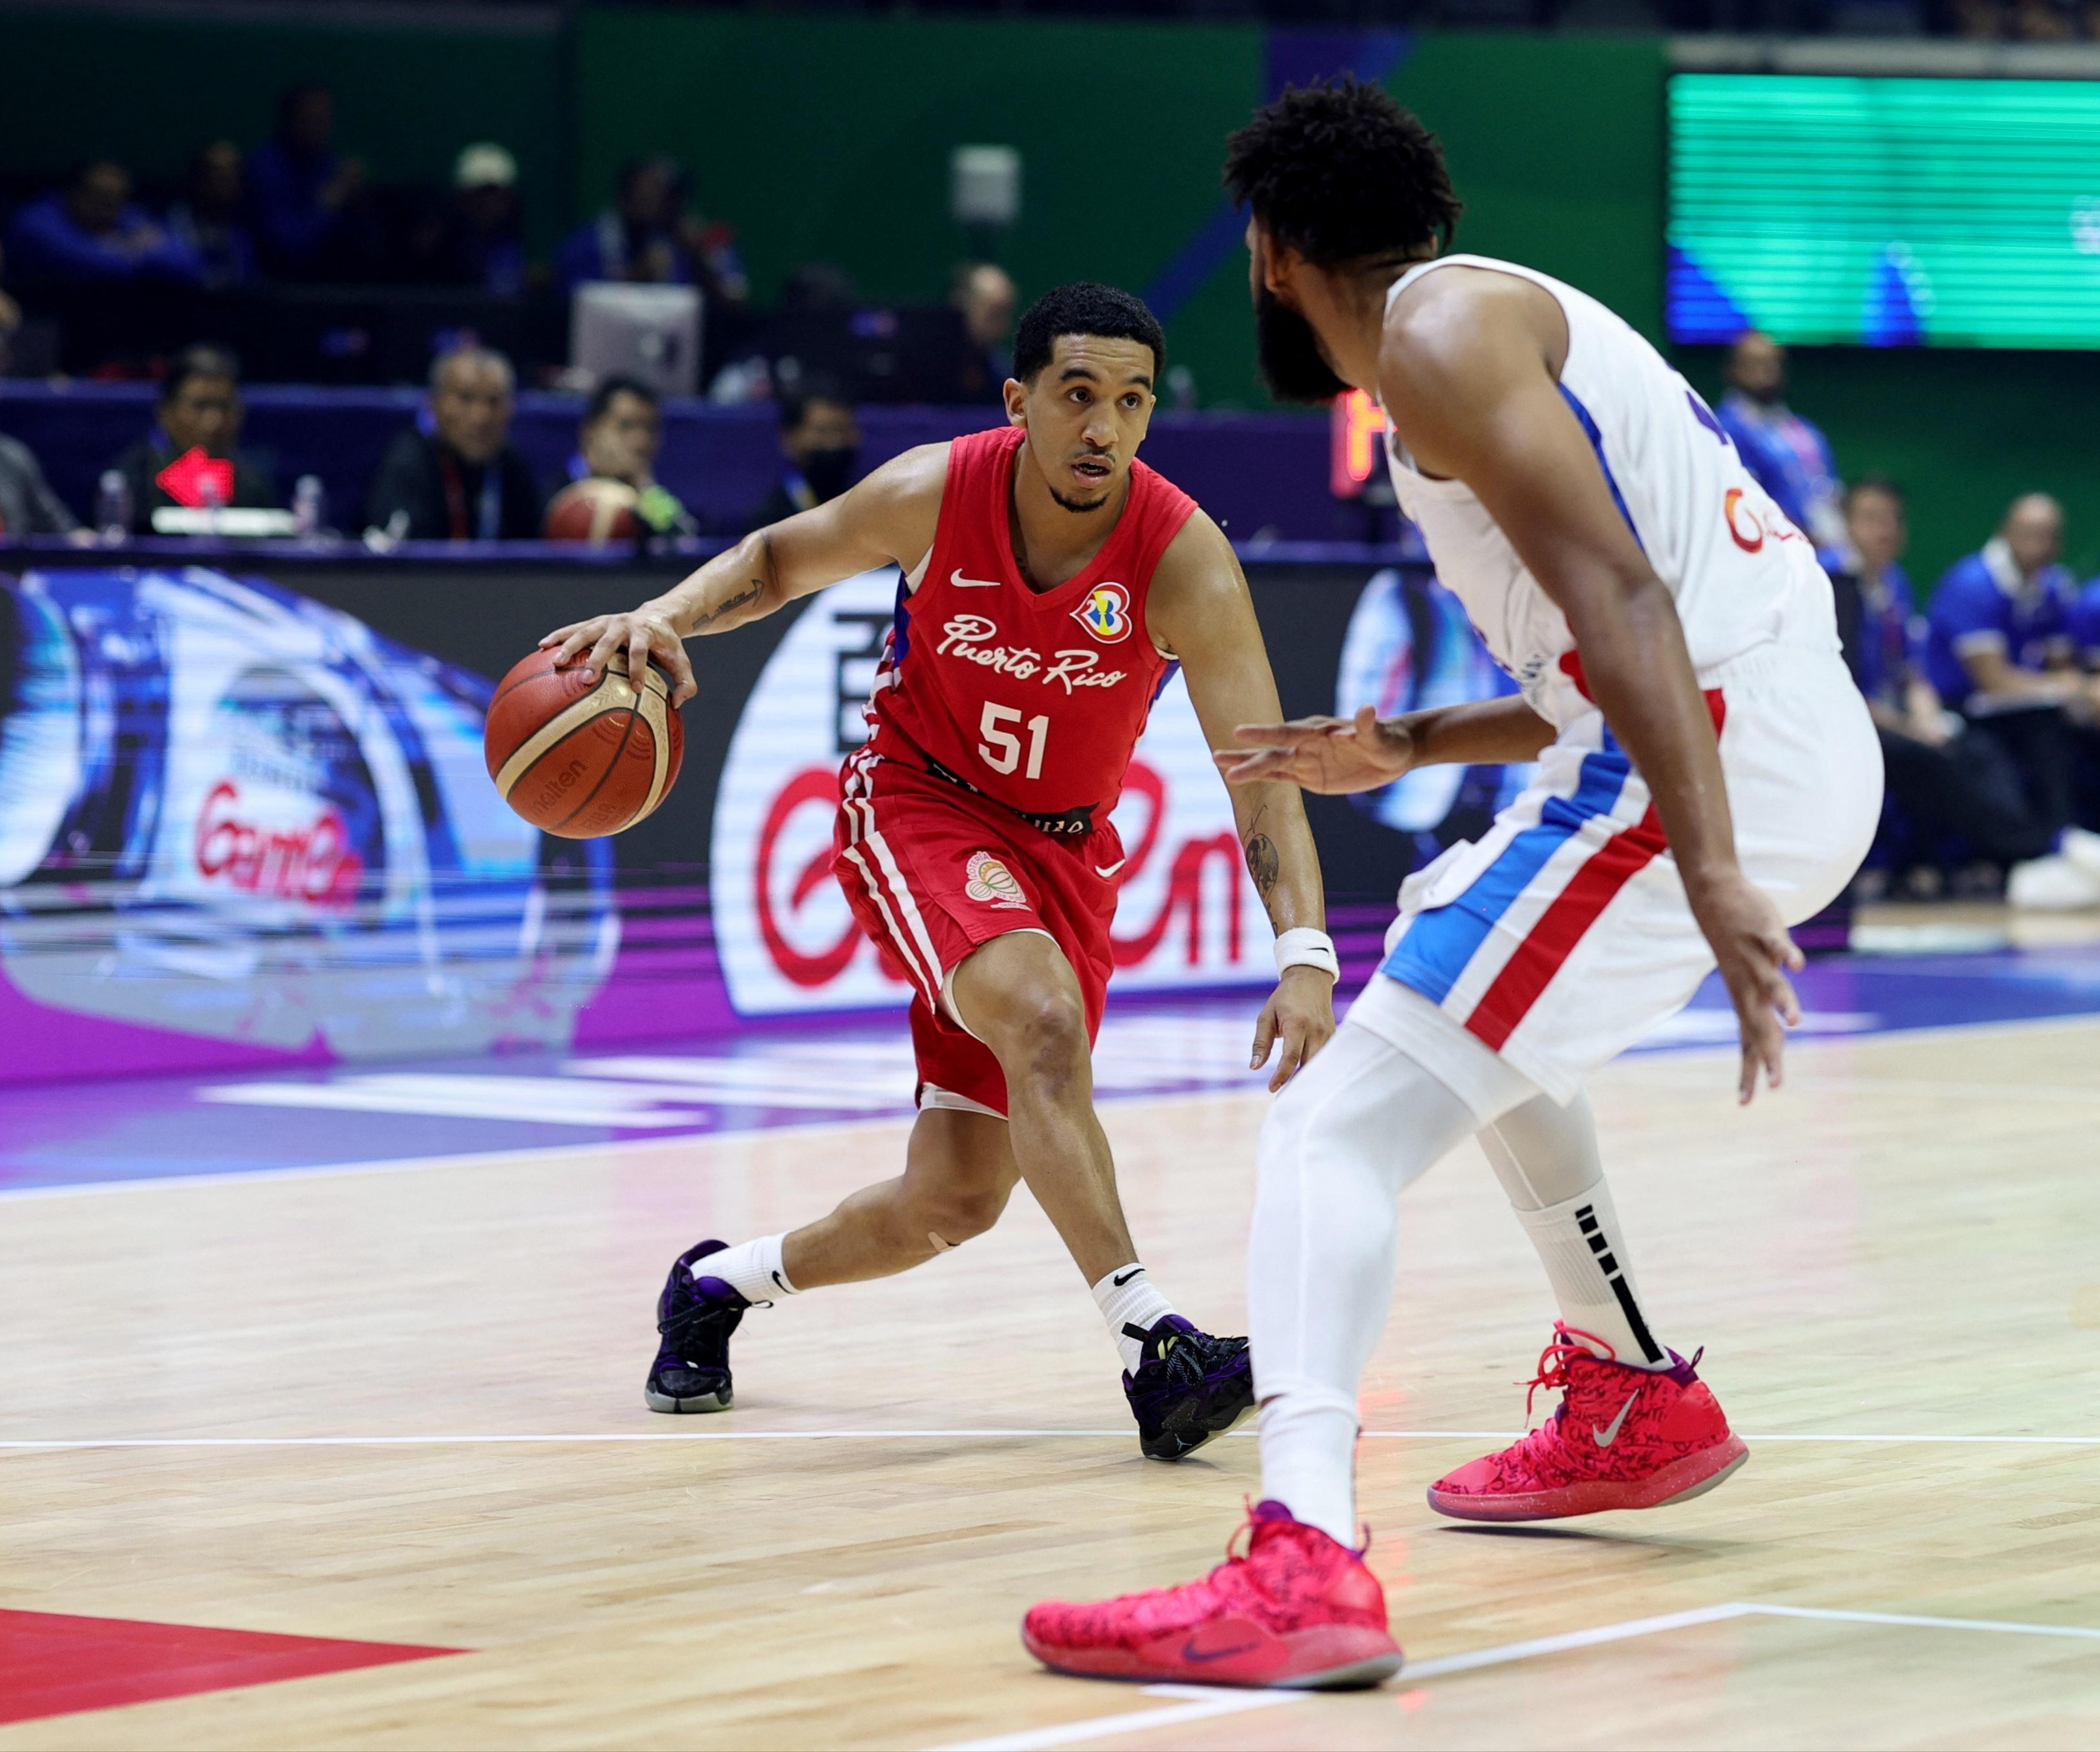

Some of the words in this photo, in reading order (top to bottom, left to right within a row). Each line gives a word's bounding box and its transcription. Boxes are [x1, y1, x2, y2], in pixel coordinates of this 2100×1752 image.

[937, 614, 1041, 679] Puerto
[1042, 650, 1127, 695] Rico
[978, 700, 1049, 780] 51
[531, 760, 588, 817] molten
